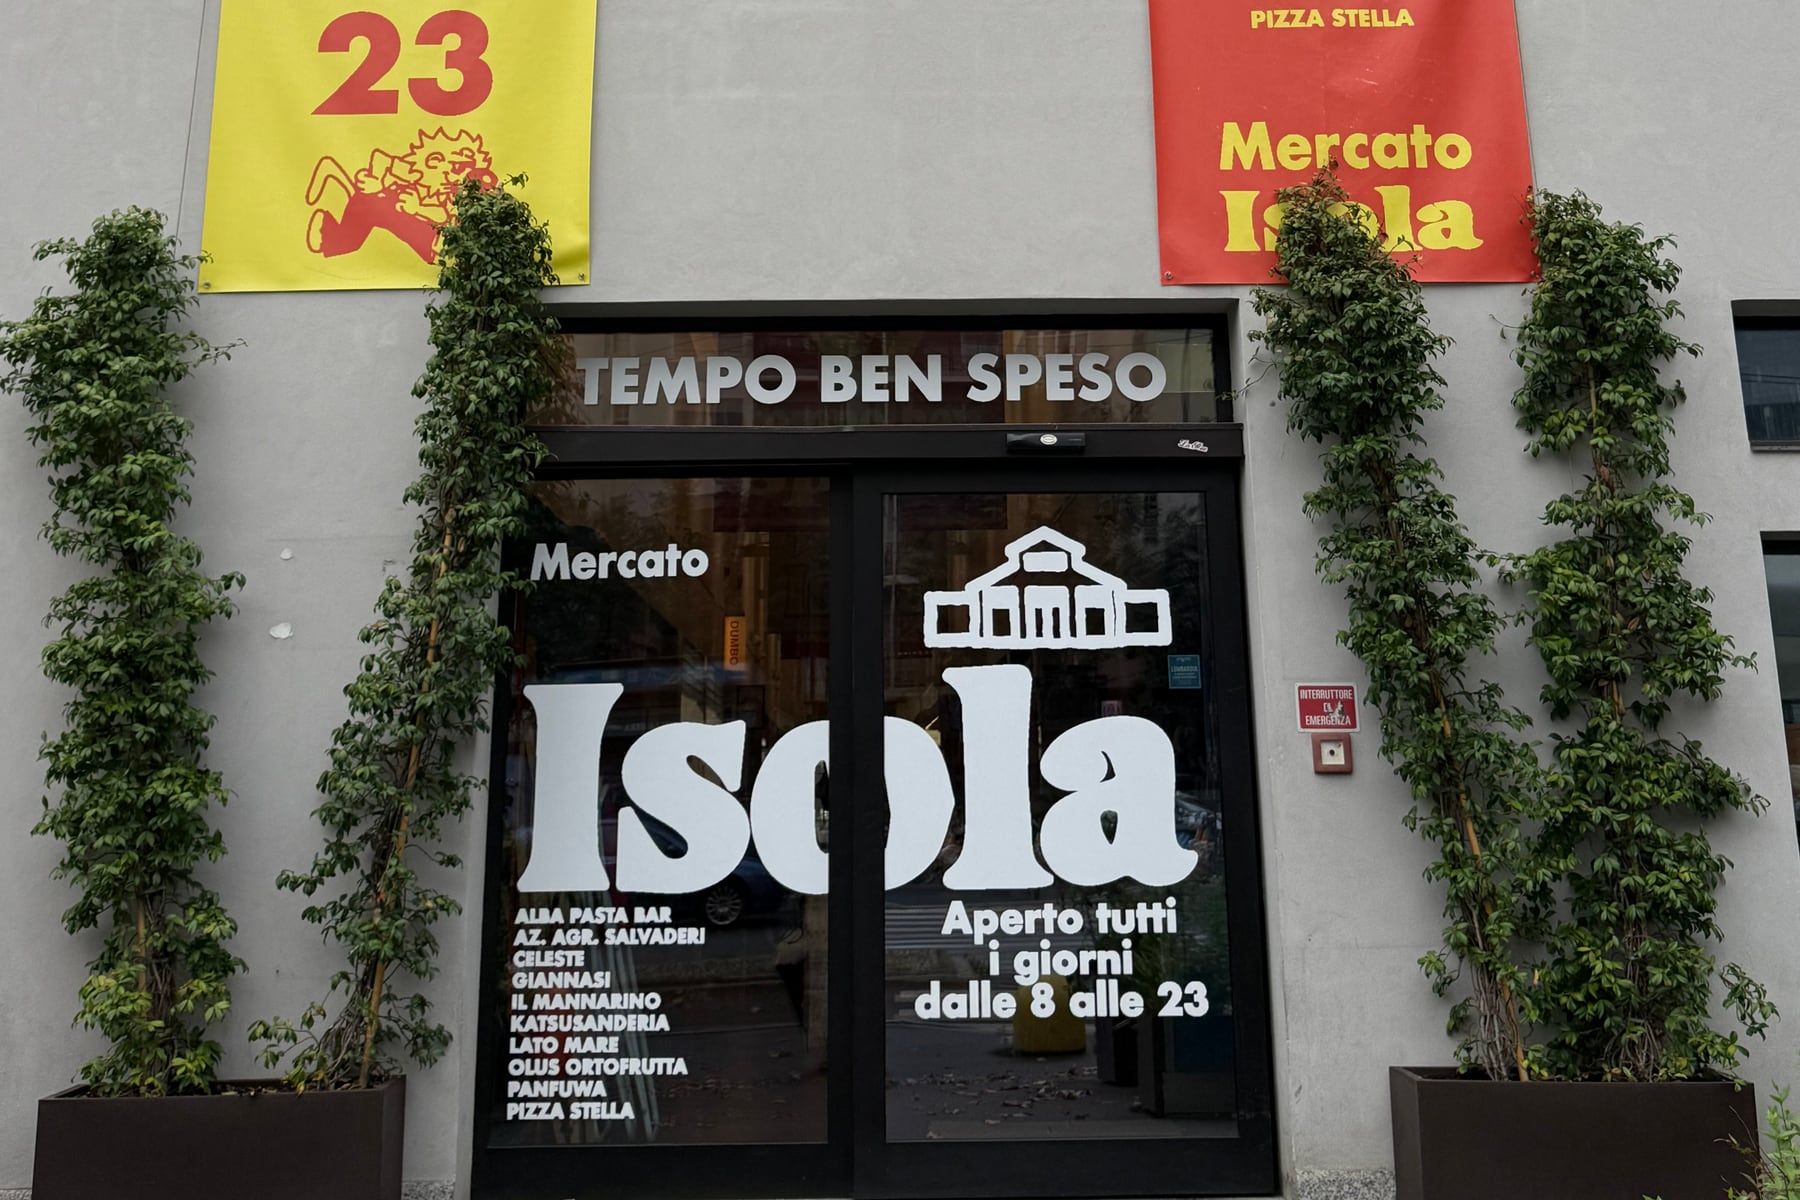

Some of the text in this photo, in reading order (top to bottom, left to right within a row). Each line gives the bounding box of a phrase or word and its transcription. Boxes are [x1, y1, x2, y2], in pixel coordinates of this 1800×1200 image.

[1251, 9, 1414, 28] PIZZA STELLA
[311, 10, 493, 116] 23
[1220, 122, 1472, 170] Mercato
[576, 353, 1166, 405] TEMPO BEN SPESO
[531, 543, 708, 580] Mercato
[1300, 689, 1352, 699] INTERRUTTORE
[517, 664, 1198, 895] Isola
[515, 907, 671, 924] ALBA PASTA BAR
[941, 897, 1176, 947] Aperto tutti
[514, 928, 705, 945] AZ. AGR. SALVADERI
[513, 950, 584, 967] CELESTE
[989, 938, 1132, 987] i giorni
[512, 972, 610, 988] GIANNASI
[512, 992, 661, 1010] IL MANNARINO
[915, 978, 1209, 1019] dalle 8 alle 23
[511, 1014, 670, 1032] KATSUSANDERIA
[510, 1037, 619, 1053] LATO MARE
[509, 1058, 688, 1075] OLUS ORTOFRUTTA
[508, 1080, 607, 1097] PANFUWA
[507, 1102, 634, 1120] PIZZA STELLA
